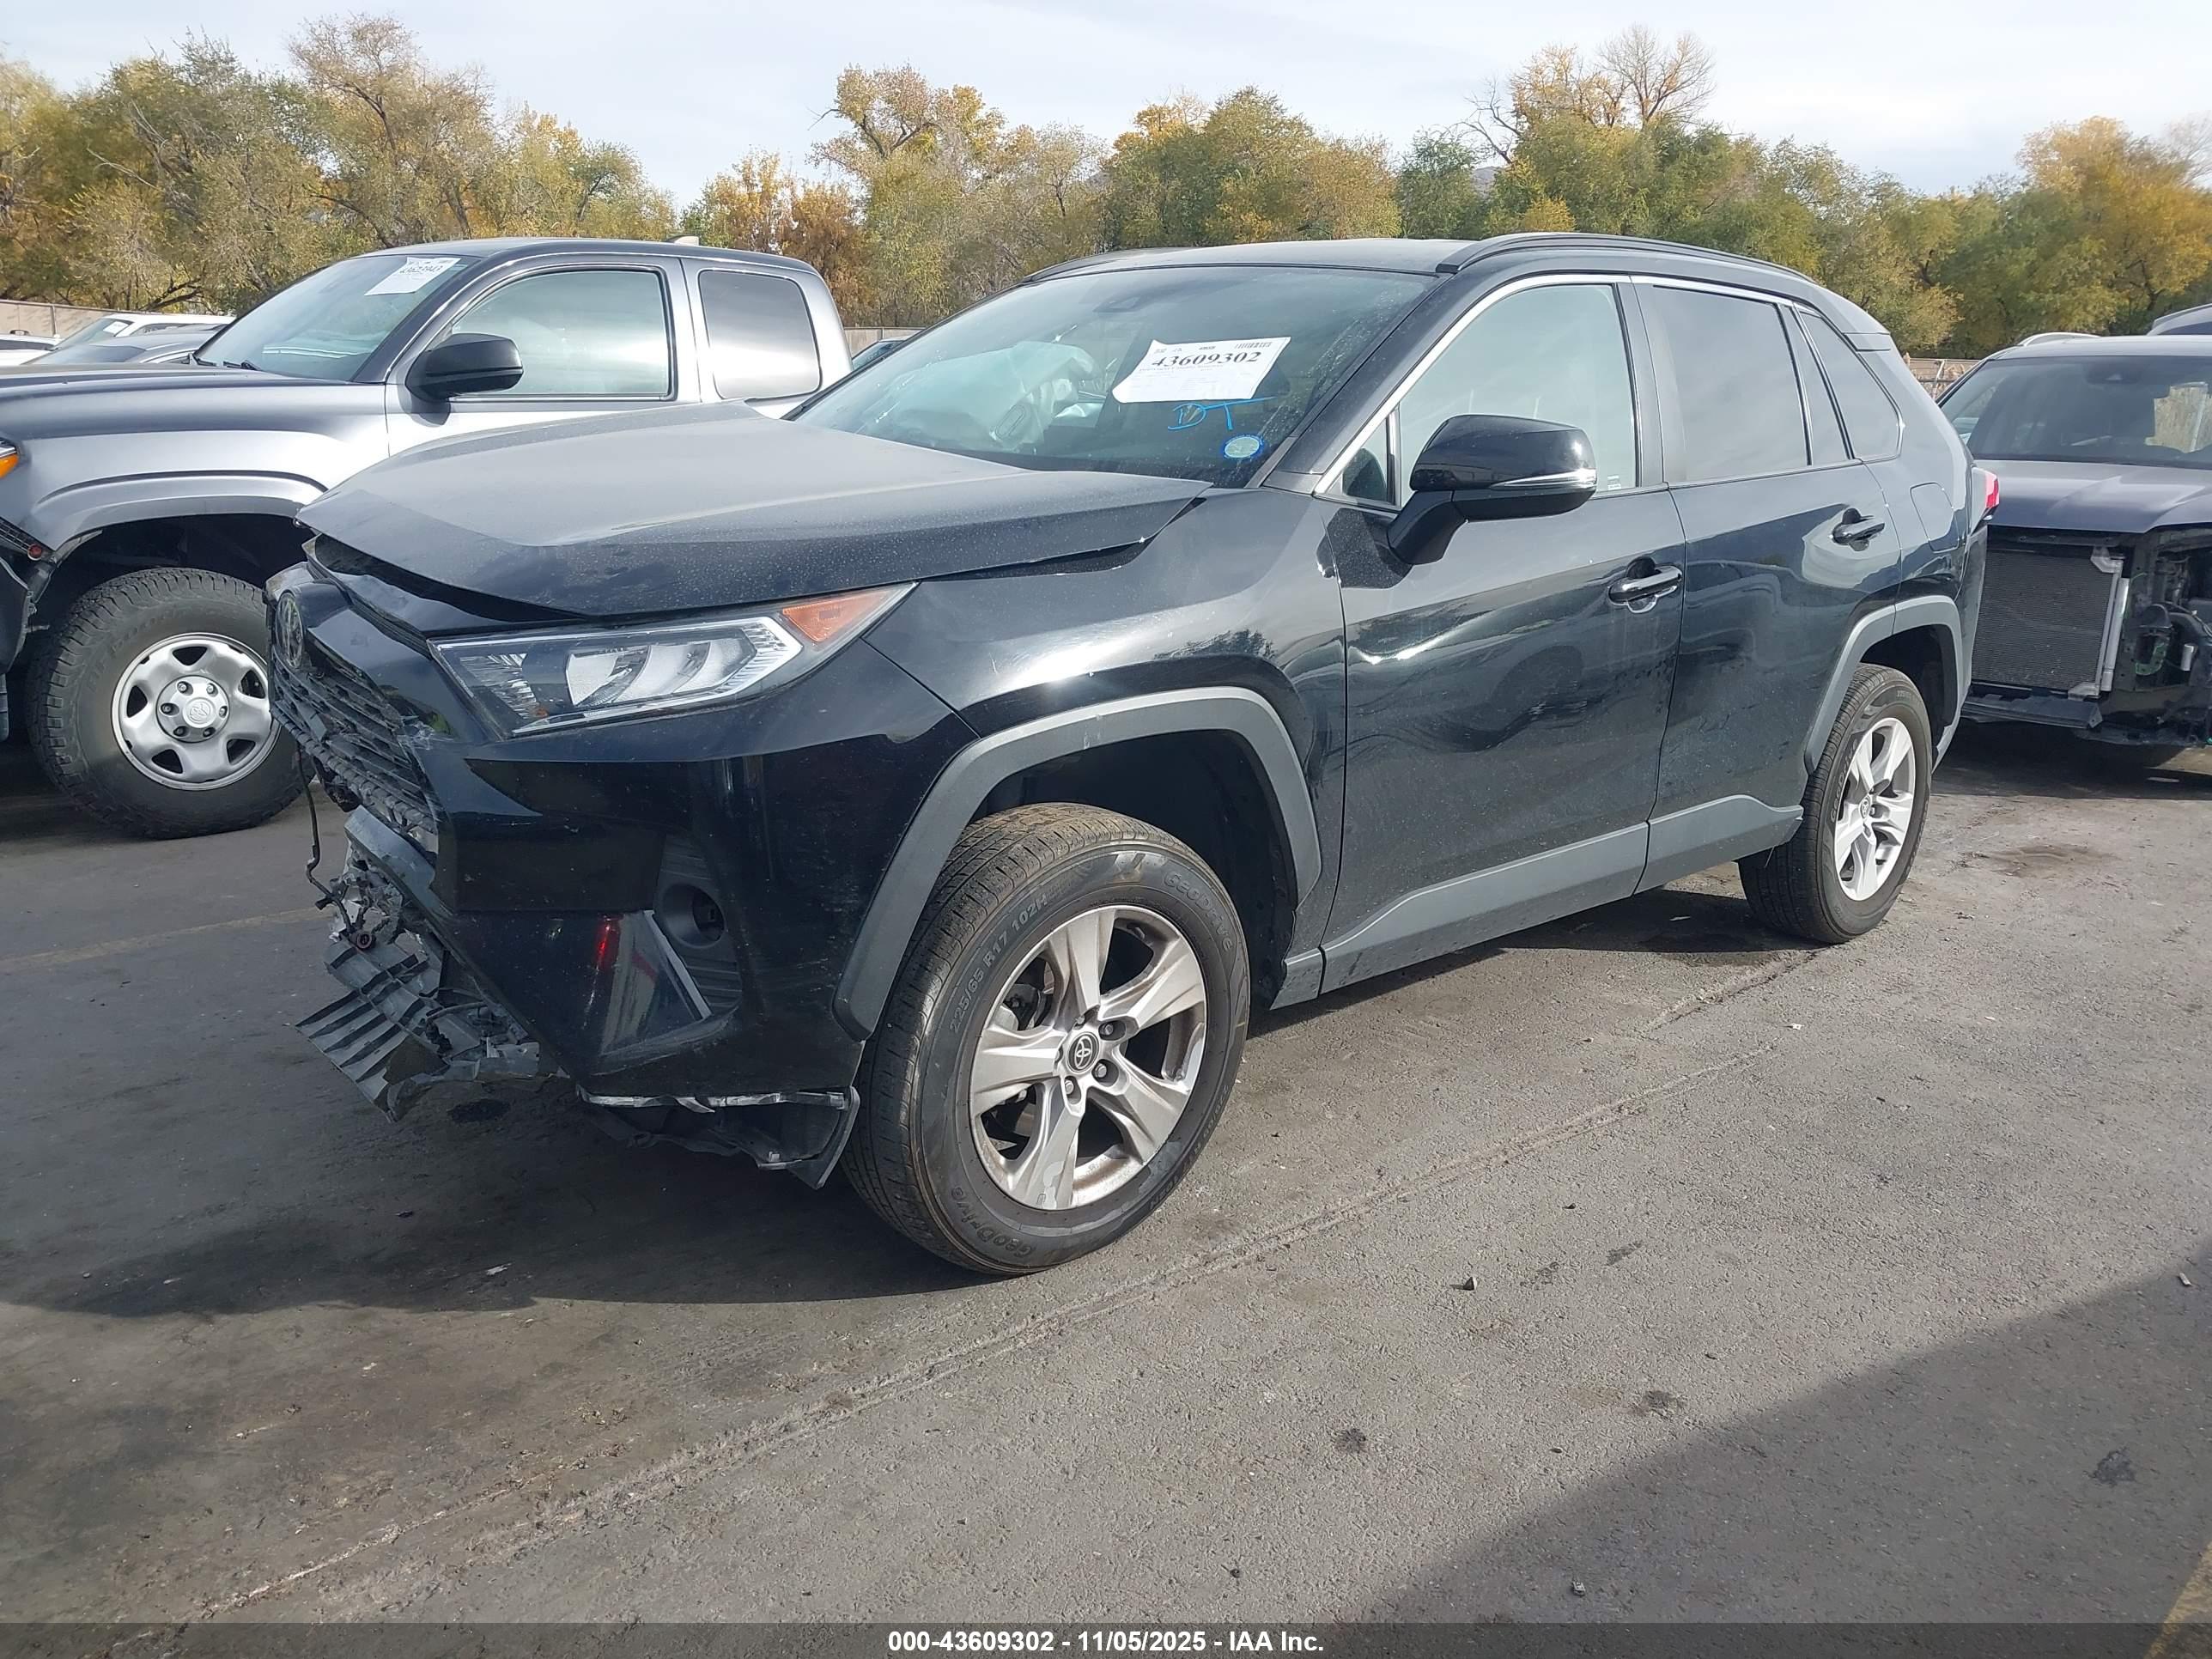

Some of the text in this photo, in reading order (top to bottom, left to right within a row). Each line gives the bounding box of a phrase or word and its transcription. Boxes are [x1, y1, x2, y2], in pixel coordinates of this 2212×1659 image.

[1152, 351, 1261, 368] 43609302
[950, 895, 1048, 1033] 225/65 R17 102H
